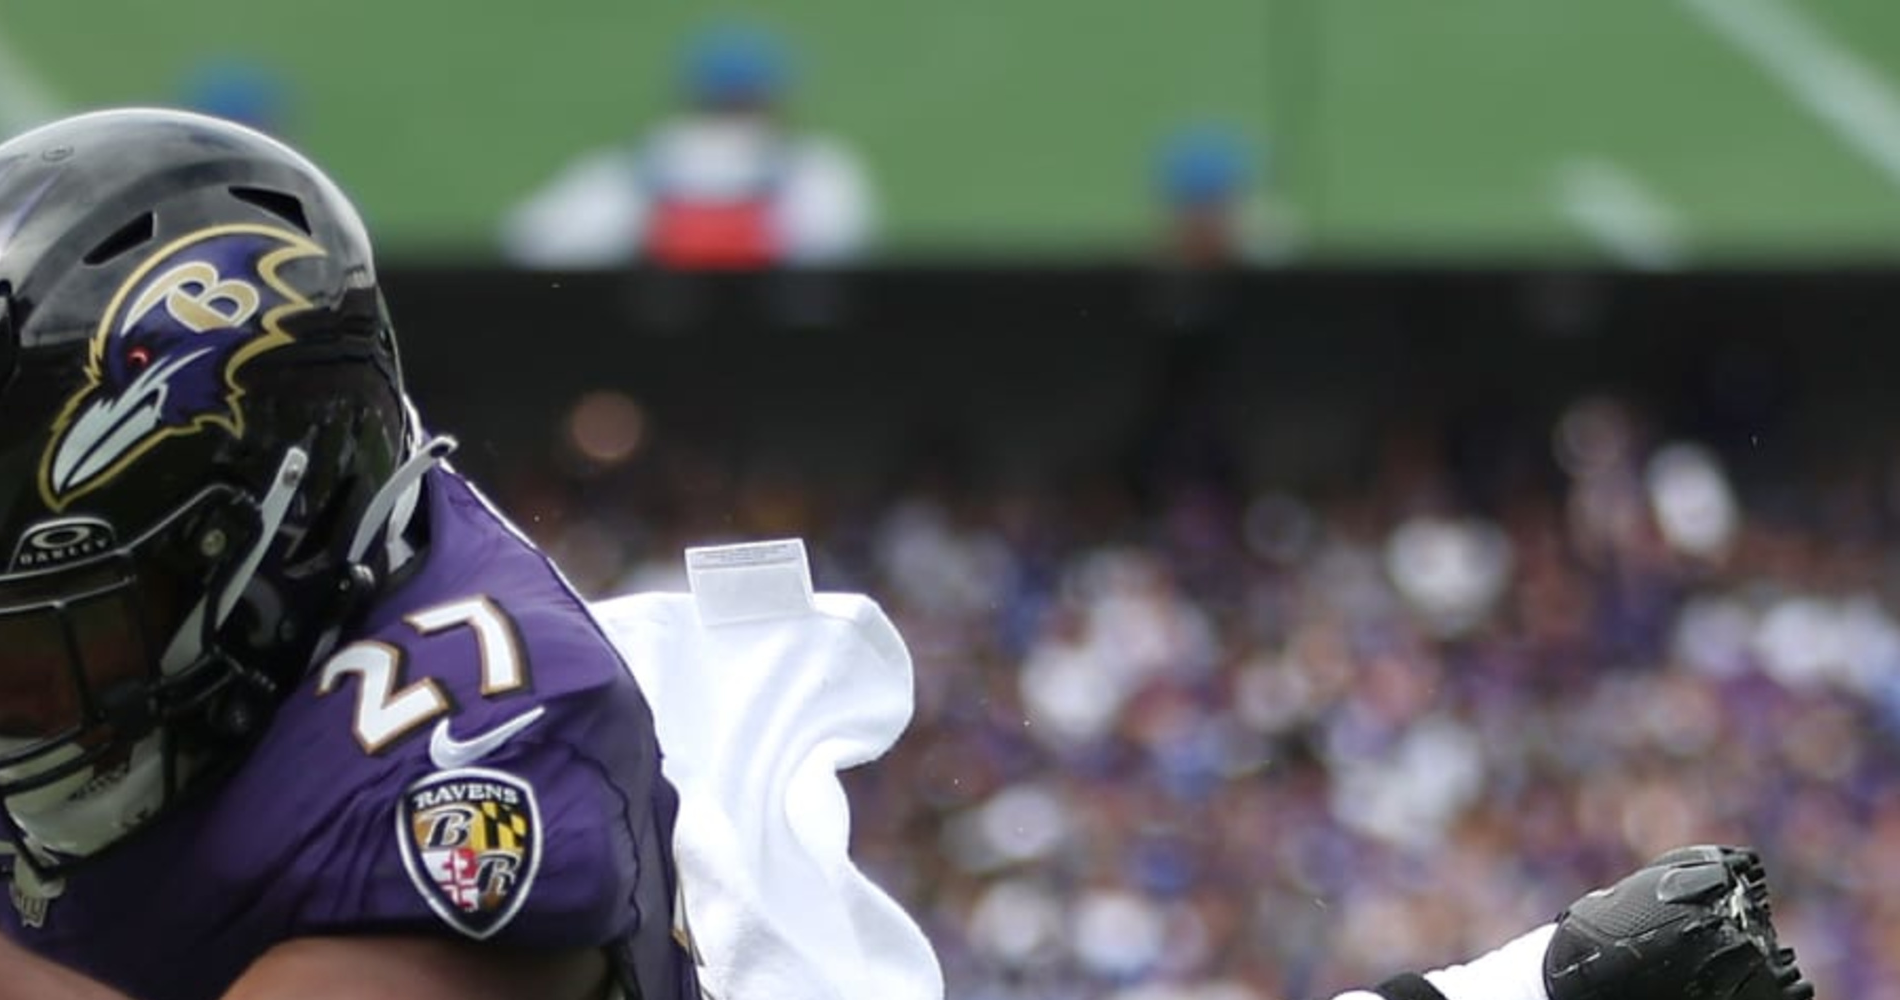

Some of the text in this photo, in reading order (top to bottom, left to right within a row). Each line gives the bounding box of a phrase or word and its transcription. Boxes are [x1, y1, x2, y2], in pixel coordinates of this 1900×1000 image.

[121, 261, 260, 337] B
[19, 540, 107, 565] OAKLEY
[314, 593, 528, 756] 27
[415, 783, 519, 810] RAVENS
